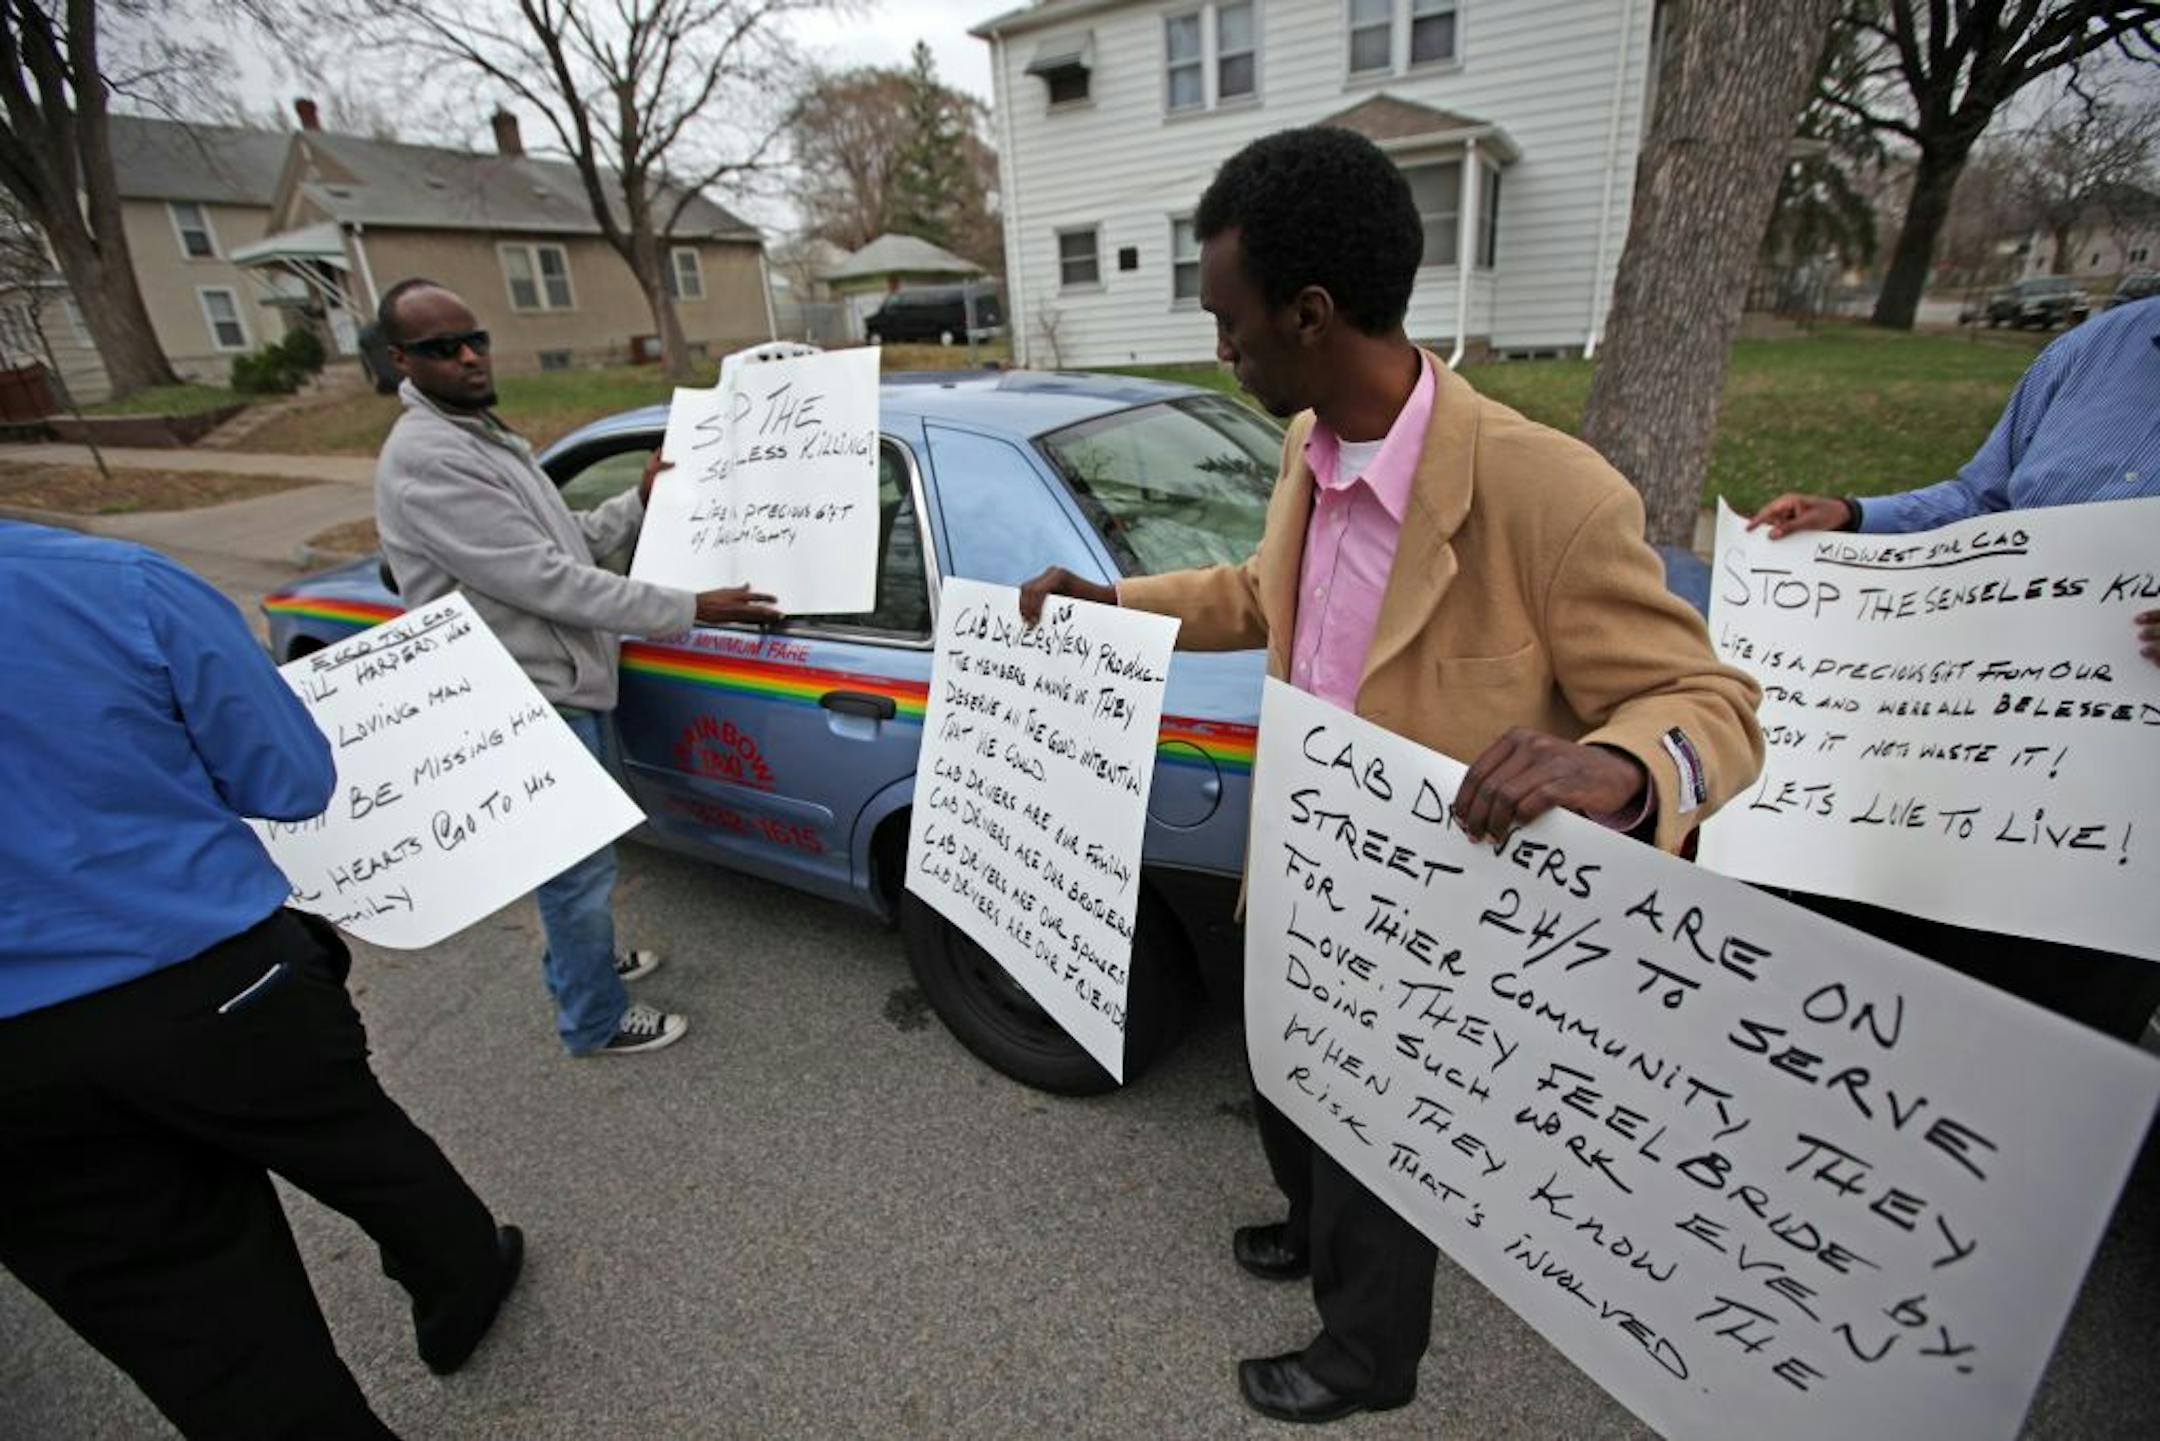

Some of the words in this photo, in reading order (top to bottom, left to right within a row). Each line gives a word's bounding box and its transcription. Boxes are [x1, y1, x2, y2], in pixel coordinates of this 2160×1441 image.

[759, 381, 825, 436] THE
[1813, 541, 1920, 565] MIDWEST
[1971, 529, 2030, 549] CAB
[953, 602, 991, 640] CAB
[1720, 548, 1841, 619] STOP
[1856, 586, 1918, 621] THE
[1924, 577, 2090, 613] SENSELESS
[2100, 572, 2160, 603] KIL
[695, 632, 763, 657] MINIMUM
[766, 639, 812, 662] FARE
[1760, 650, 1785, 668] IS
[1787, 655, 1806, 672] A
[2049, 660, 2114, 683] OUR
[428, 679, 472, 707] MAN
[945, 679, 1001, 717] DESERVE
[975, 658, 1026, 687] MEMBERS
[1092, 687, 1137, 731] THEY
[1764, 685, 1809, 708] TOR
[1815, 696, 1860, 713] AND
[1937, 698, 1977, 717] ALL
[673, 714, 775, 782] RAINBOW
[1918, 743, 1998, 764] WASTE
[349, 780, 404, 821] BE
[933, 757, 963, 784] CAB
[1022, 801, 1052, 833] ARE
[1054, 826, 1080, 857] OUR
[1749, 774, 1836, 816] LETS
[1850, 794, 1927, 826] LIVE
[1939, 806, 1982, 840] TO
[326, 835, 424, 895] HEARTS
[478, 789, 514, 822] TO
[929, 785, 959, 816] CAB
[1013, 841, 1043, 871] ARE
[1042, 860, 1066, 893] OUR
[919, 851, 951, 886] CAB
[1005, 916, 1033, 950] ARE
[1034, 939, 1060, 976] OUR
[923, 823, 958, 857] CAB
[1010, 885, 1037, 913] ARE
[1038, 903, 1068, 941] OUR
[1302, 724, 1394, 802] CAB
[1624, 887, 1773, 982] ARE
[1801, 981, 1905, 1050] ON
[1289, 788, 1465, 888] STREET
[1478, 887, 1612, 971] 24/7
[1637, 957, 1703, 1010] TO
[1727, 1017, 2000, 1182] SERVE
[1282, 841, 1346, 913] FOR
[1785, 1132, 1979, 1270] THEY
[1397, 978, 1521, 1072] THEY
[1536, 1062, 1668, 1164] FEEL
[1283, 1013, 1391, 1096] WHEN
[1405, 1096, 1508, 1177] THEY
[1694, 1296, 1830, 1392] THE
[1395, 1032, 1491, 1103] SUCH
[1514, 1106, 1634, 1195] WORK
[1674, 1213, 1900, 1363] EVEN
